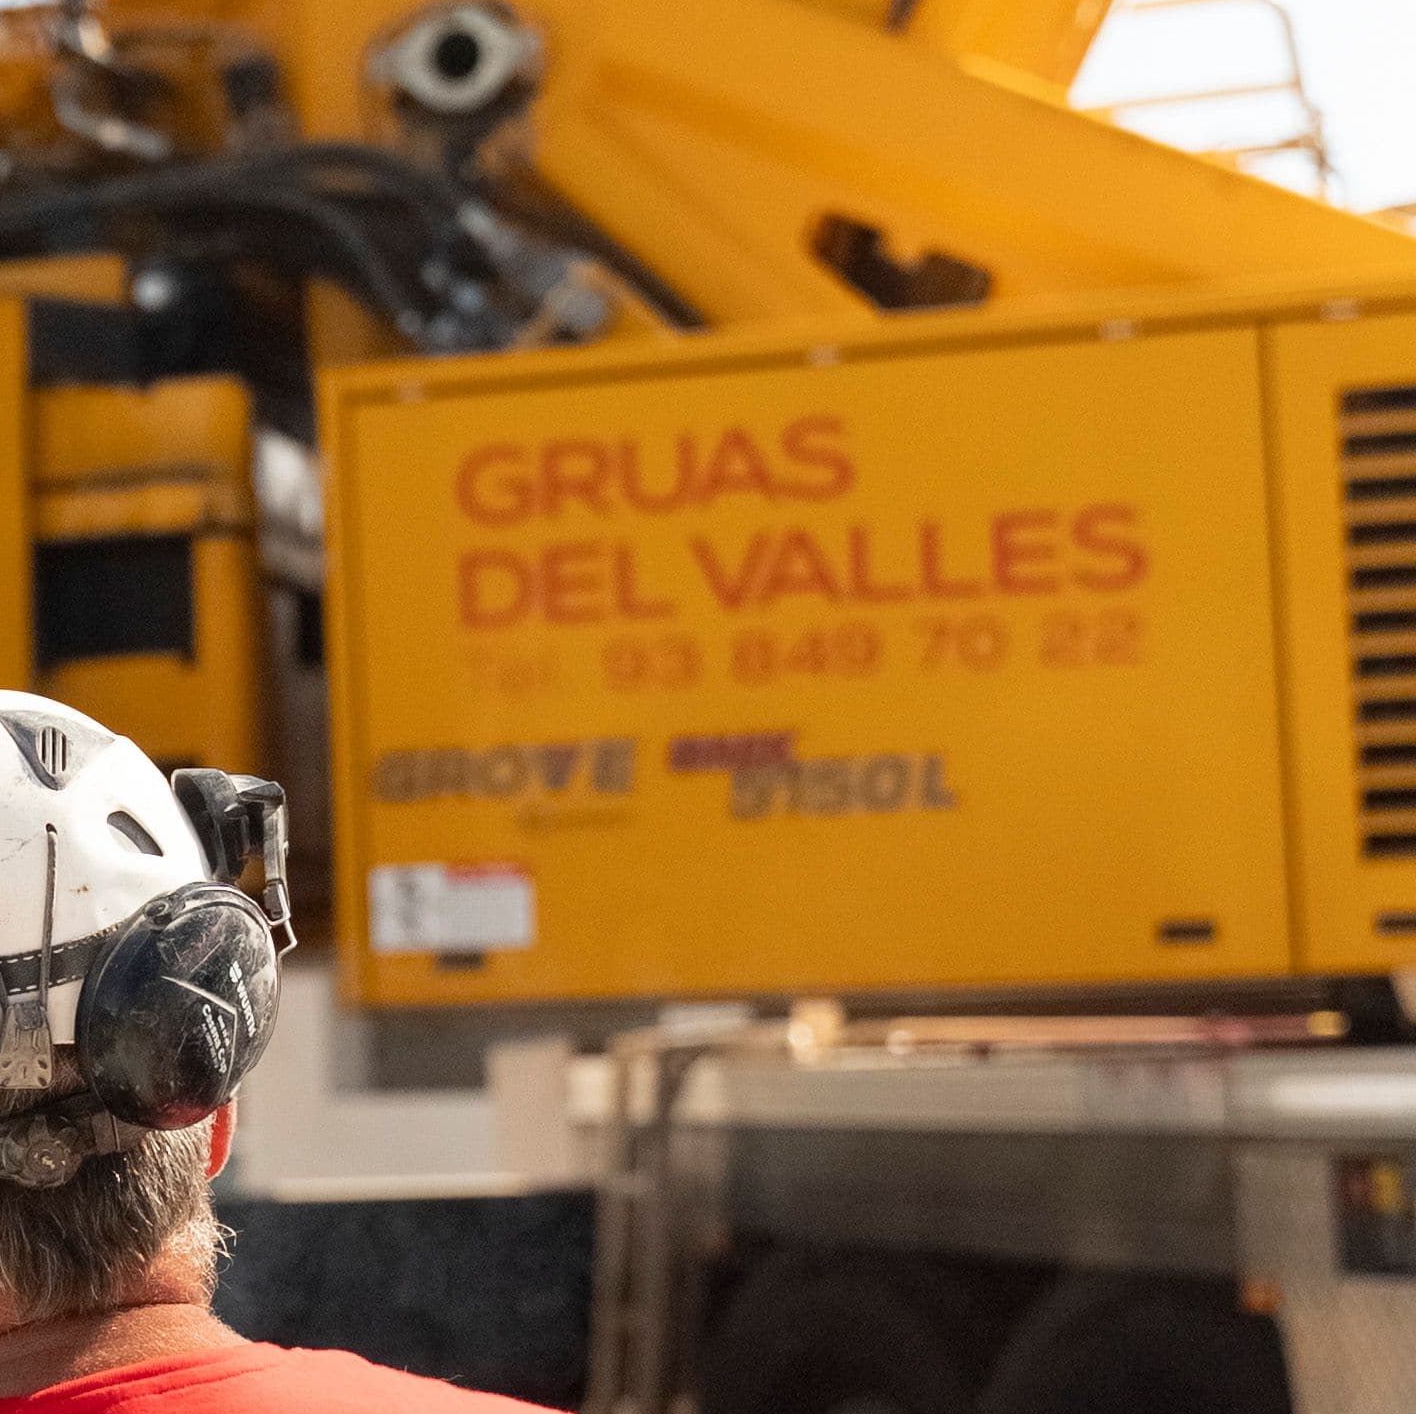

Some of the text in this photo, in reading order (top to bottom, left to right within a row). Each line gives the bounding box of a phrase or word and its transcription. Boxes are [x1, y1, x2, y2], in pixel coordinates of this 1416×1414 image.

[454, 415, 857, 527] GRUAS
[457, 501, 1151, 631] DEL VALLES
